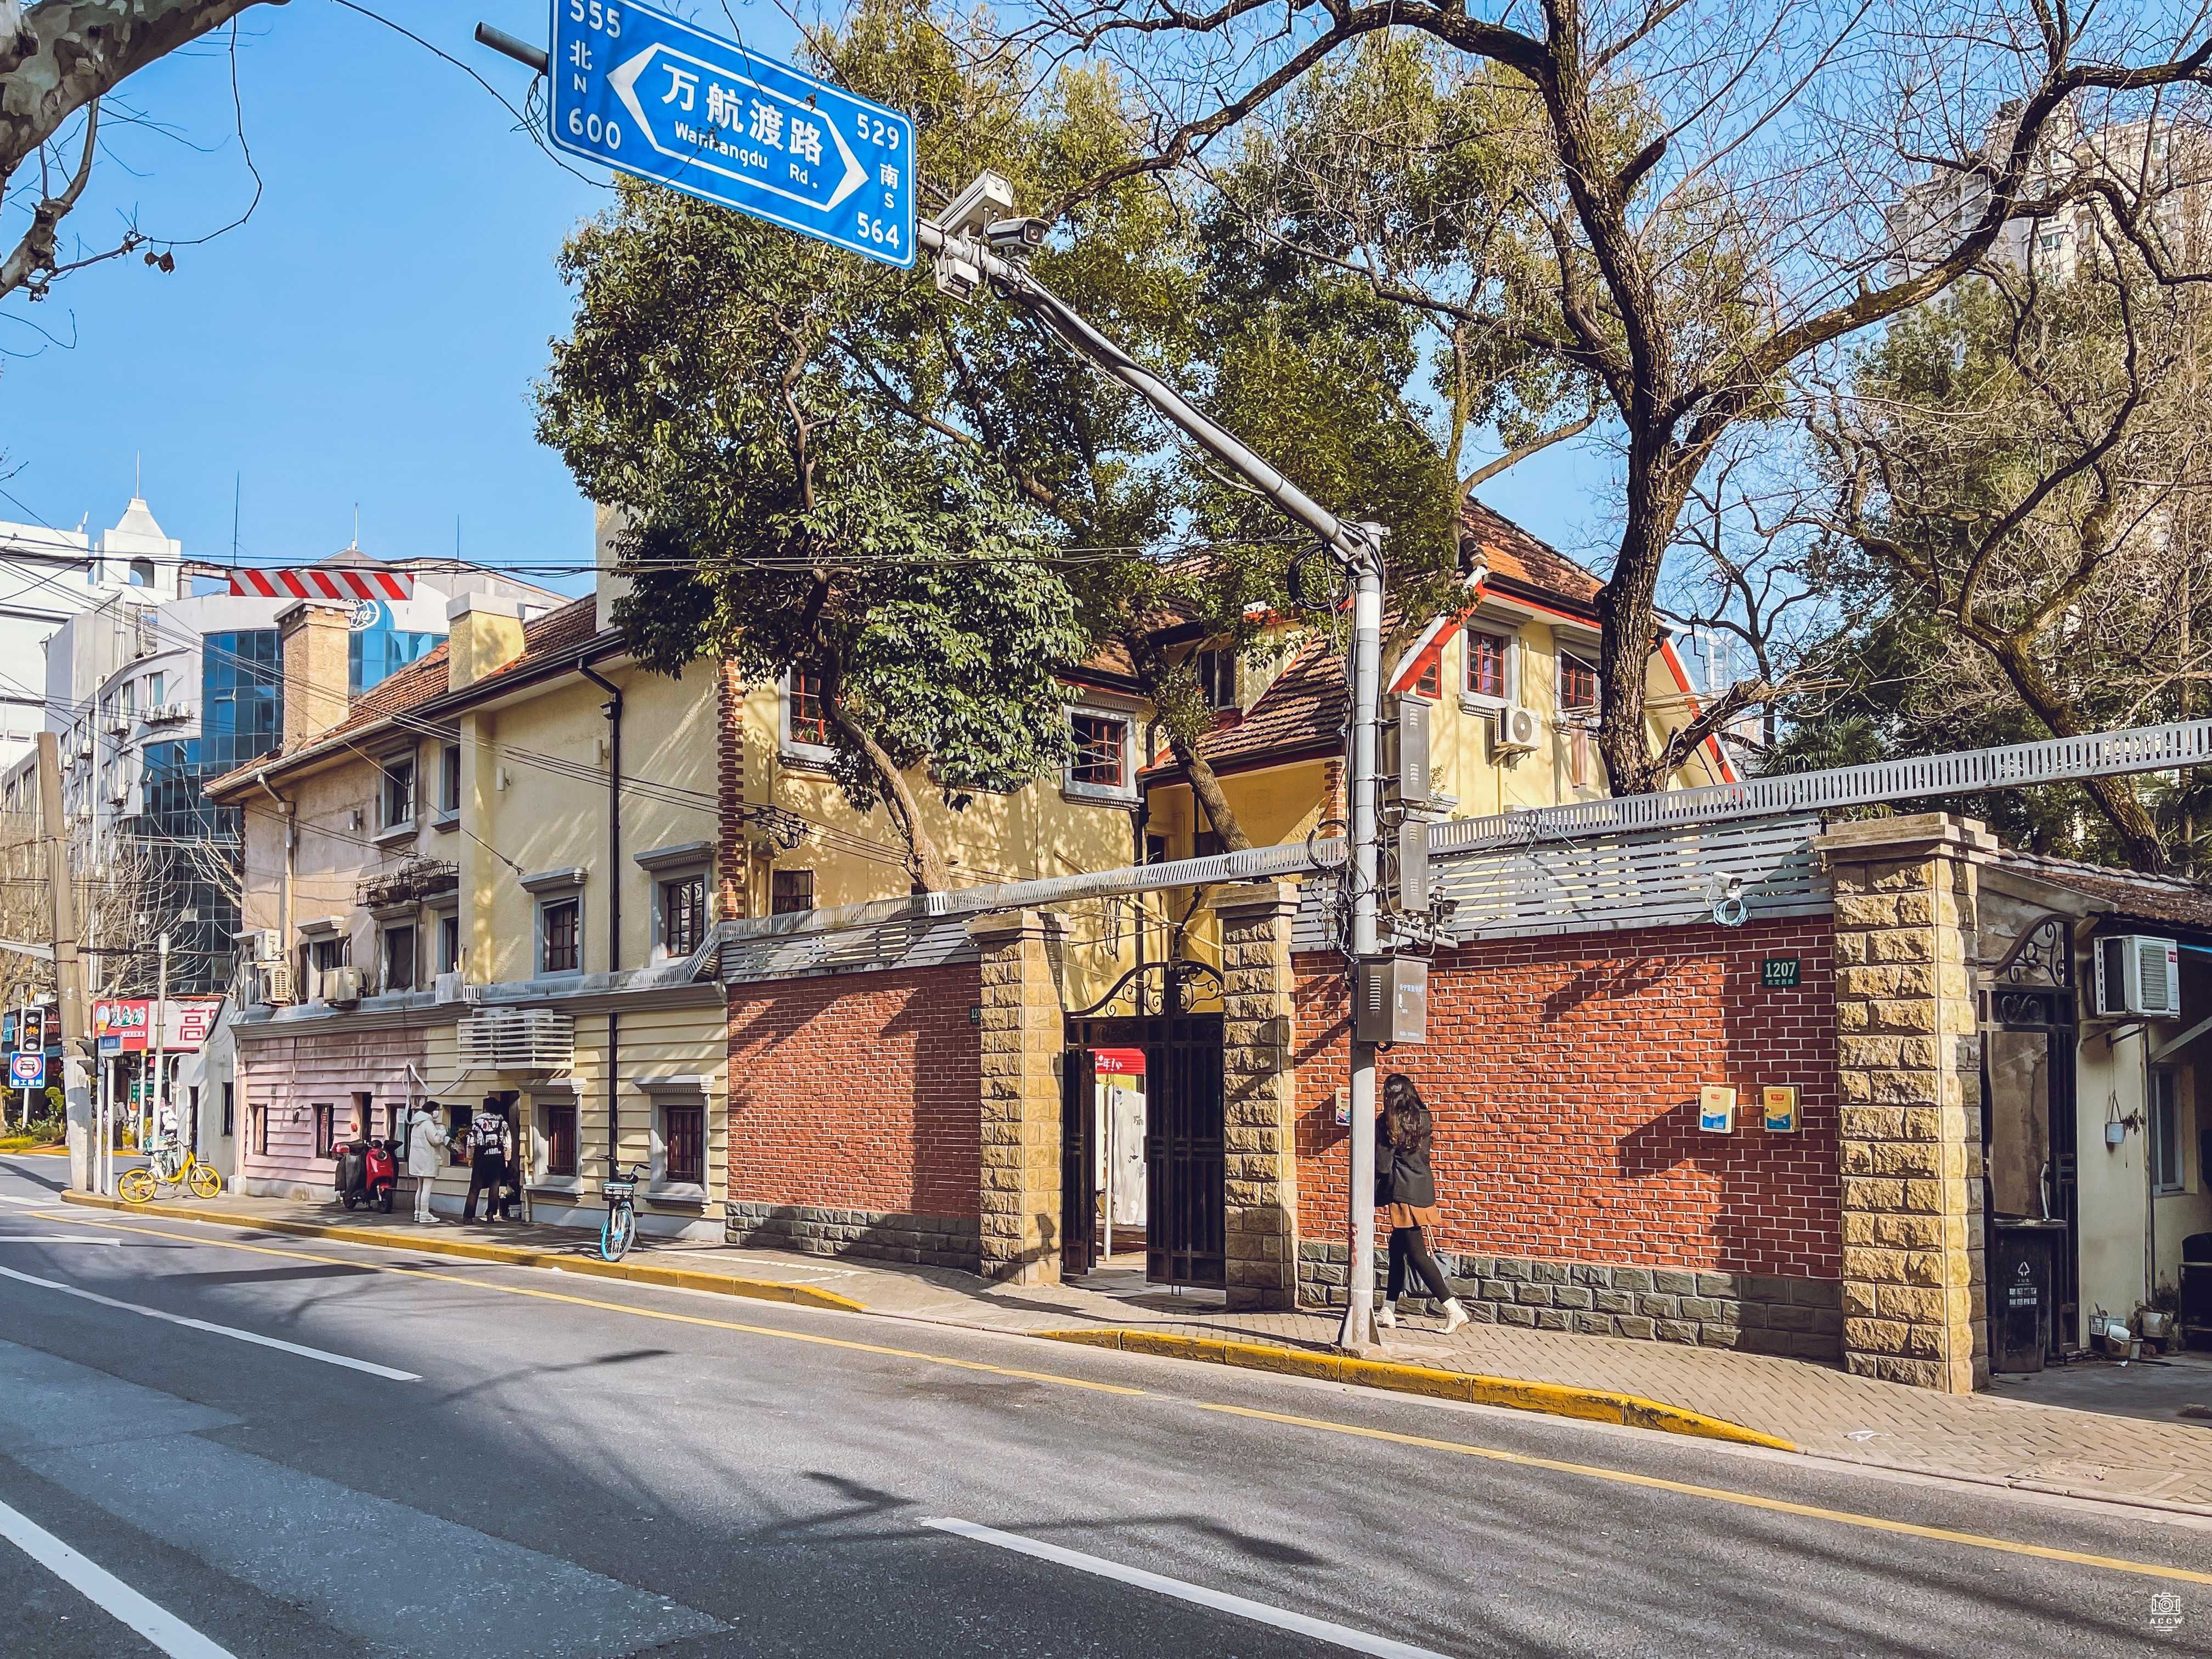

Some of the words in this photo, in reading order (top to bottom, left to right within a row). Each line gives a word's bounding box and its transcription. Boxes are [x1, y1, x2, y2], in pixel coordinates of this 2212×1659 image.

[571, 0, 620, 38] 555
[569, 40, 592, 70] 北
[574, 73, 587, 94] N
[569, 108, 622, 150] 600
[661, 63, 823, 167] 万航渡路
[856, 112, 900, 151] 529
[879, 163, 899, 190] 南
[884, 193, 895, 209] S
[856, 211, 900, 250] 564
[1765, 962, 1796, 977] 1207
